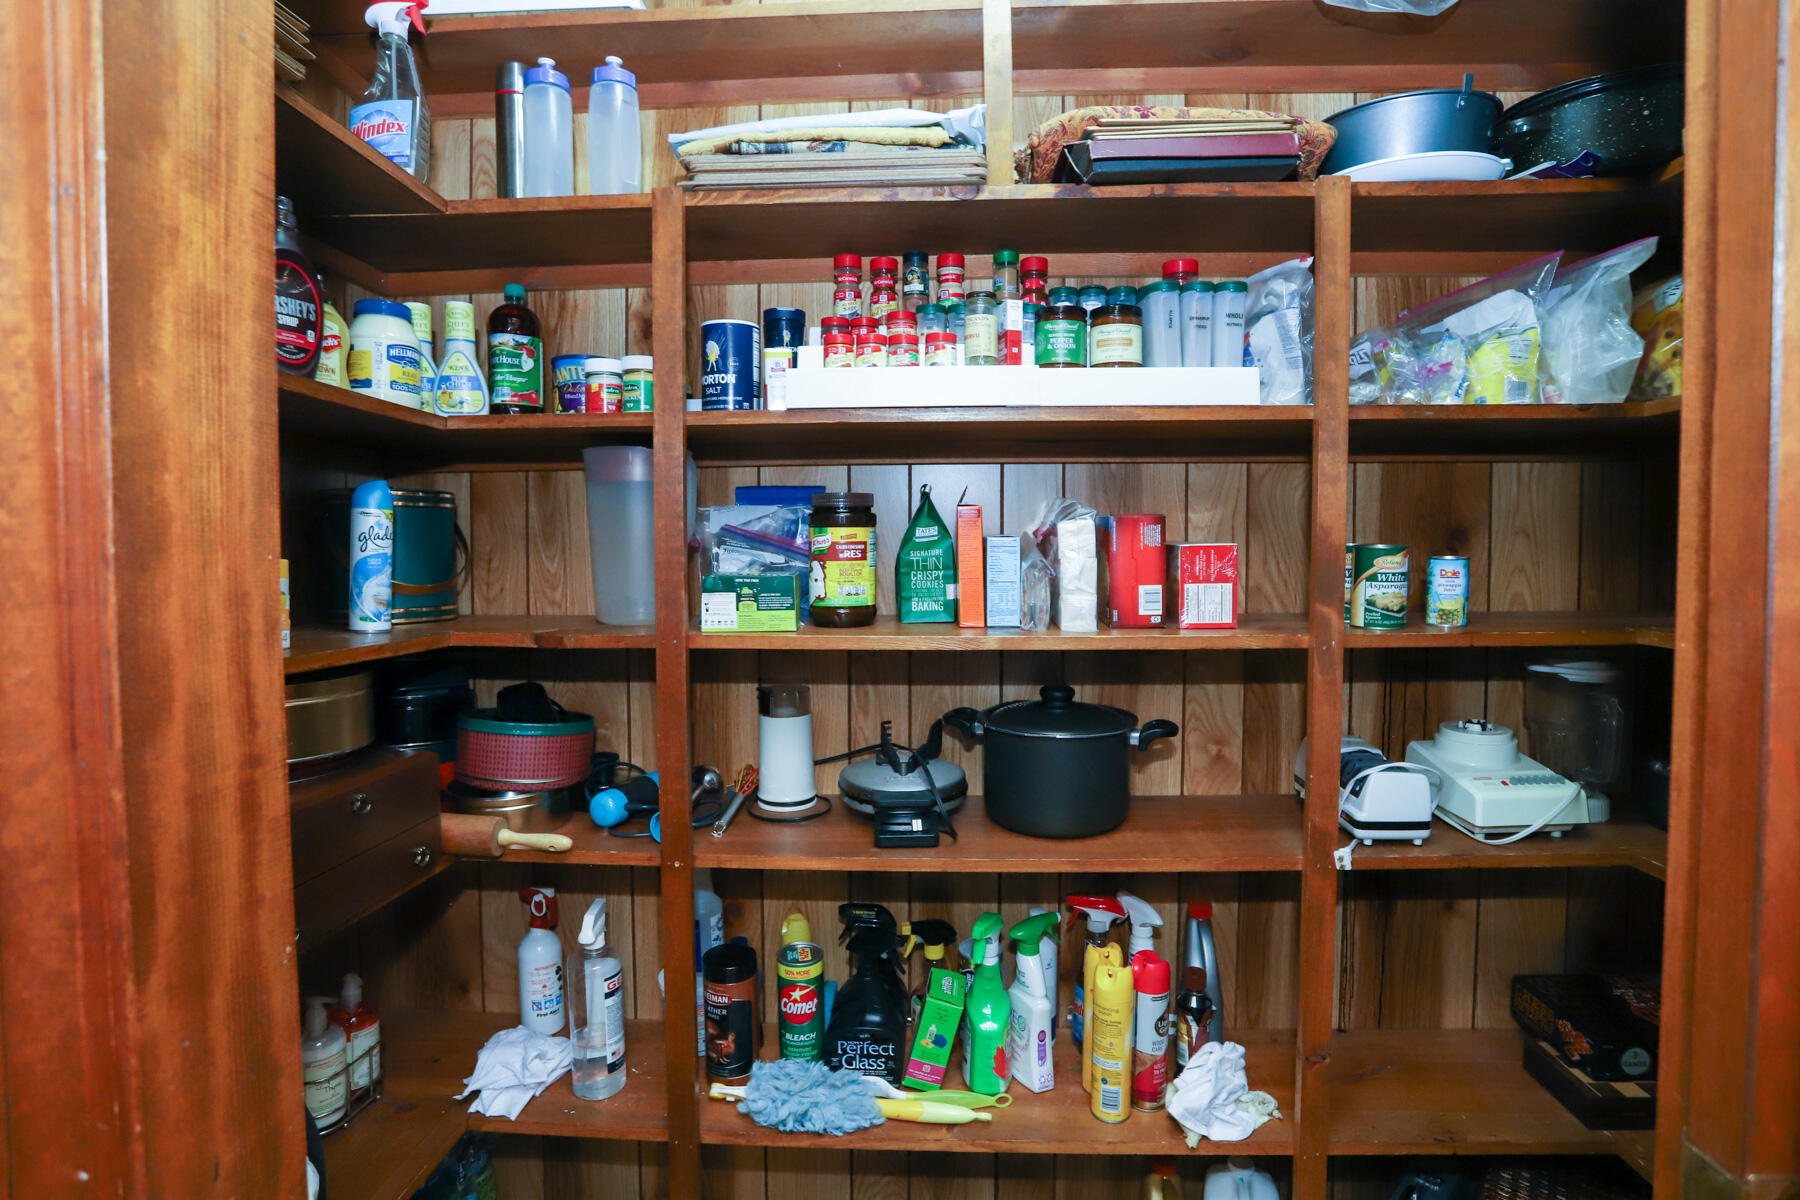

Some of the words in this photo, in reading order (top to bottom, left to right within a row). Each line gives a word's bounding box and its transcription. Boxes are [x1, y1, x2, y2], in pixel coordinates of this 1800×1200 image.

[352, 118, 406, 140] Windex
[702, 373, 737, 386] ORTON
[705, 386, 722, 395] SALT
[843, 549, 862, 559] RES
[909, 549, 944, 557] SIGNATURE
[909, 556, 943, 571] THIN
[910, 571, 944, 581] CRISPY
[1377, 573, 1406, 582] White
[1439, 568, 1461, 578] Dole
[911, 580, 944, 589] COOKIES
[911, 601, 944, 612] BAKING
[780, 997, 819, 1016] Comet
[785, 1031, 817, 1041] BLEACH
[837, 1040, 895, 1056] Perfect
[841, 1053, 886, 1070] Glass
